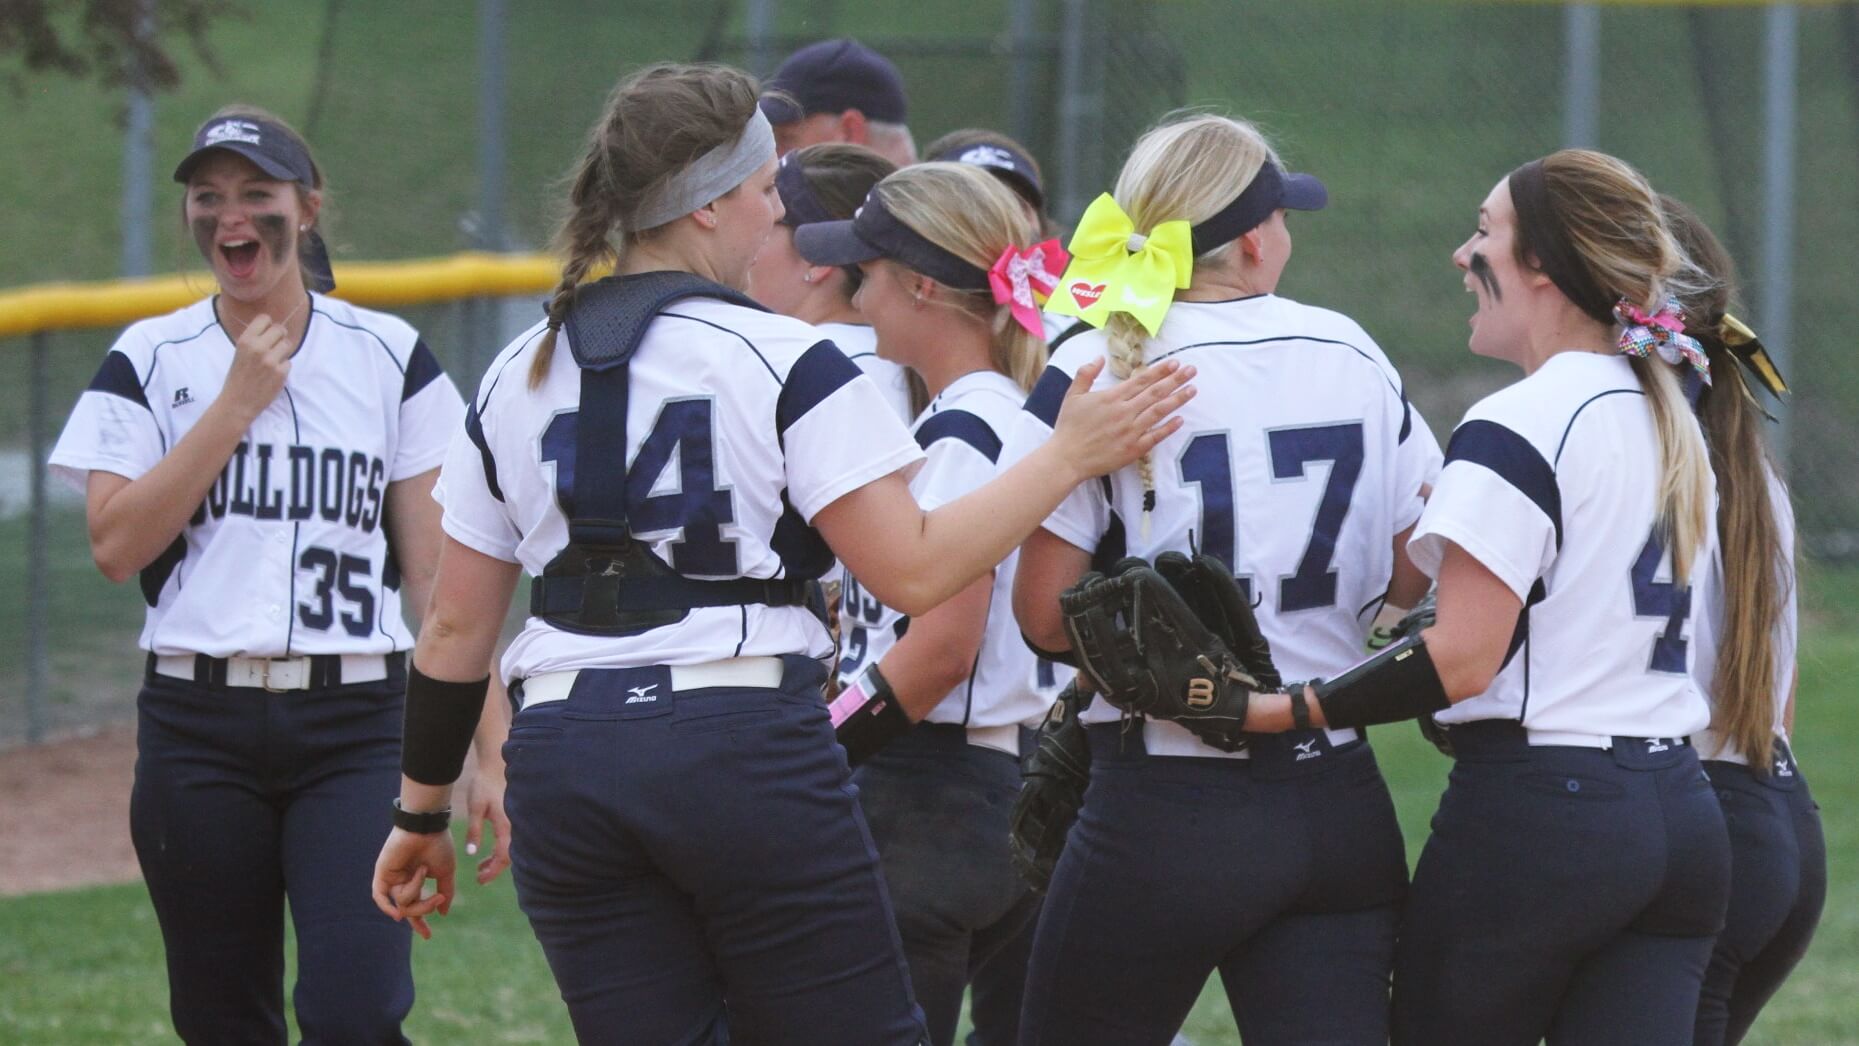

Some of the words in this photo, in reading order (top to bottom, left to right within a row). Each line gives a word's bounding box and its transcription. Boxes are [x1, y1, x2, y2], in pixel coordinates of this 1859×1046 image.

[189, 441, 385, 535] ULLDOGS
[1175, 418, 1365, 616] 17
[298, 546, 377, 638] 35
[1627, 508, 1695, 677] 4
